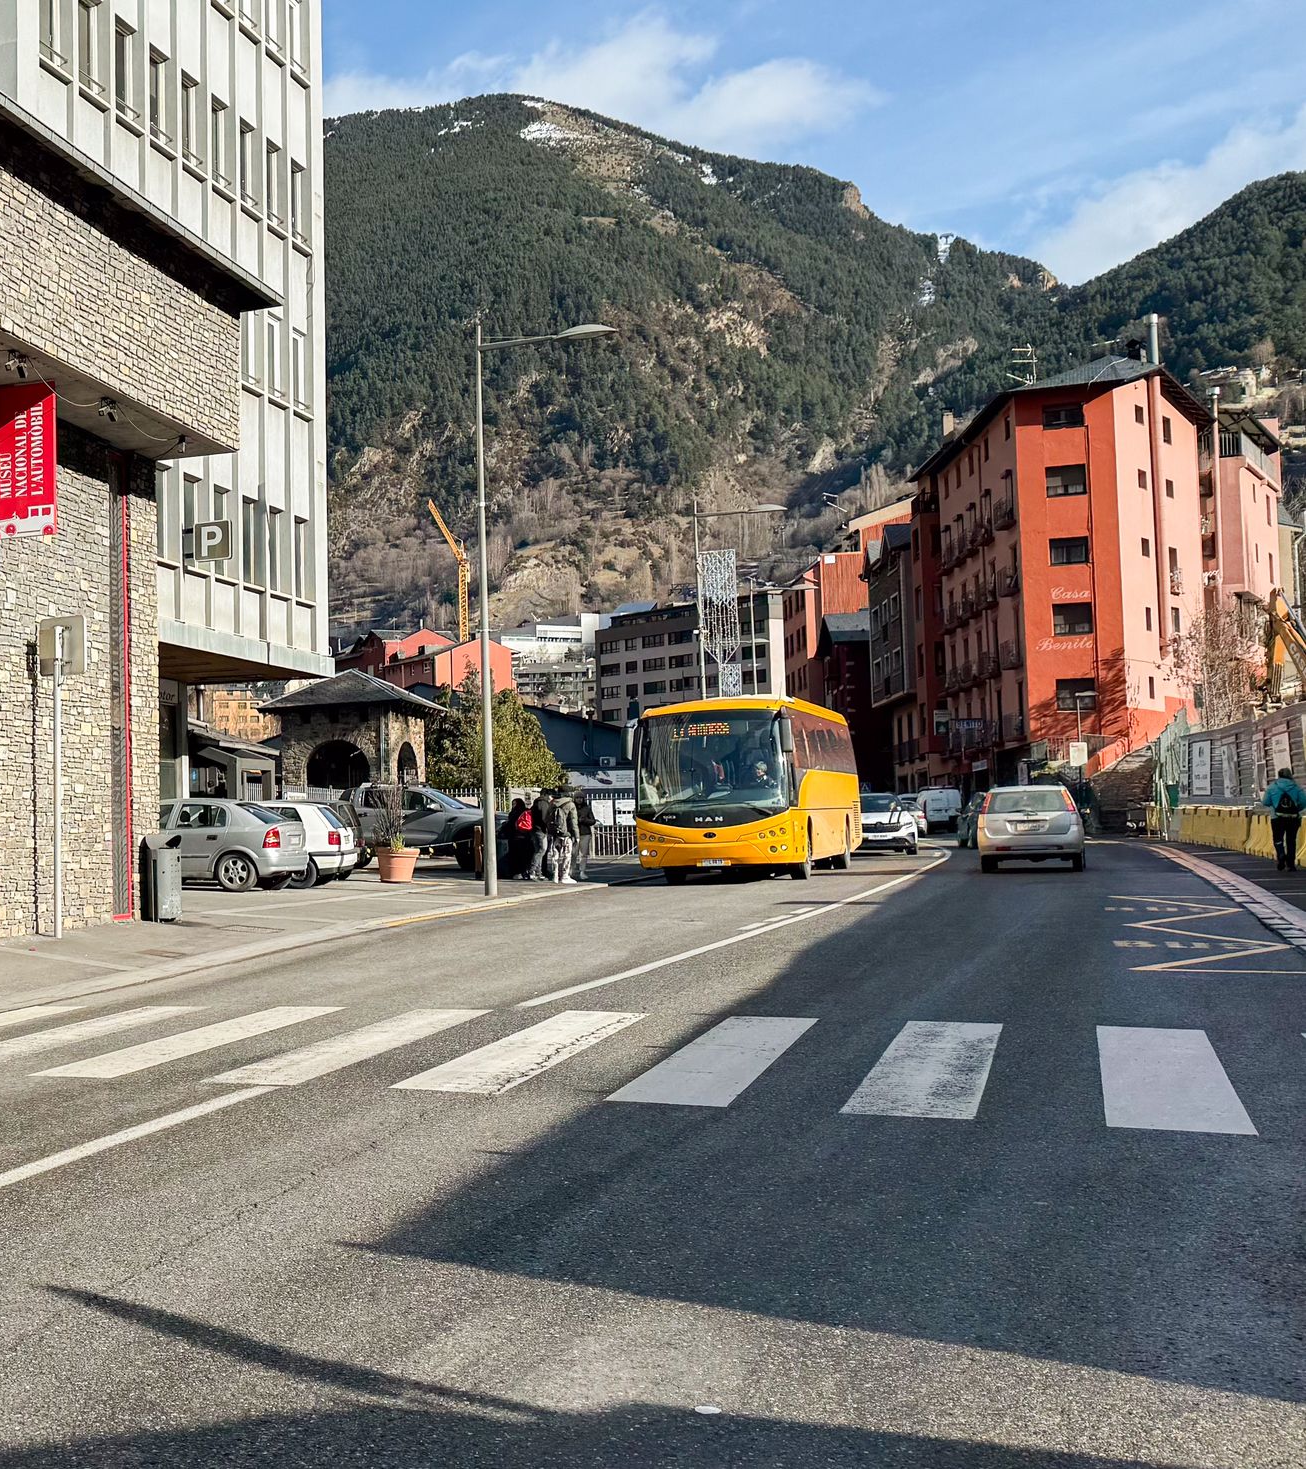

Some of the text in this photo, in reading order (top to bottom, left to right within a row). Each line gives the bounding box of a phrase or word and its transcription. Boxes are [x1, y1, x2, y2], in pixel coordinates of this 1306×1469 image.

[15, 410, 28, 498] NACIONAL DE
[28, 401, 44, 497] L'AUTOMÒBIL
[0, 452, 13, 499] MUSEU
[201, 525, 223, 557] P
[1051, 587, 1091, 599] Casa
[1035, 636, 1093, 651] Benito
